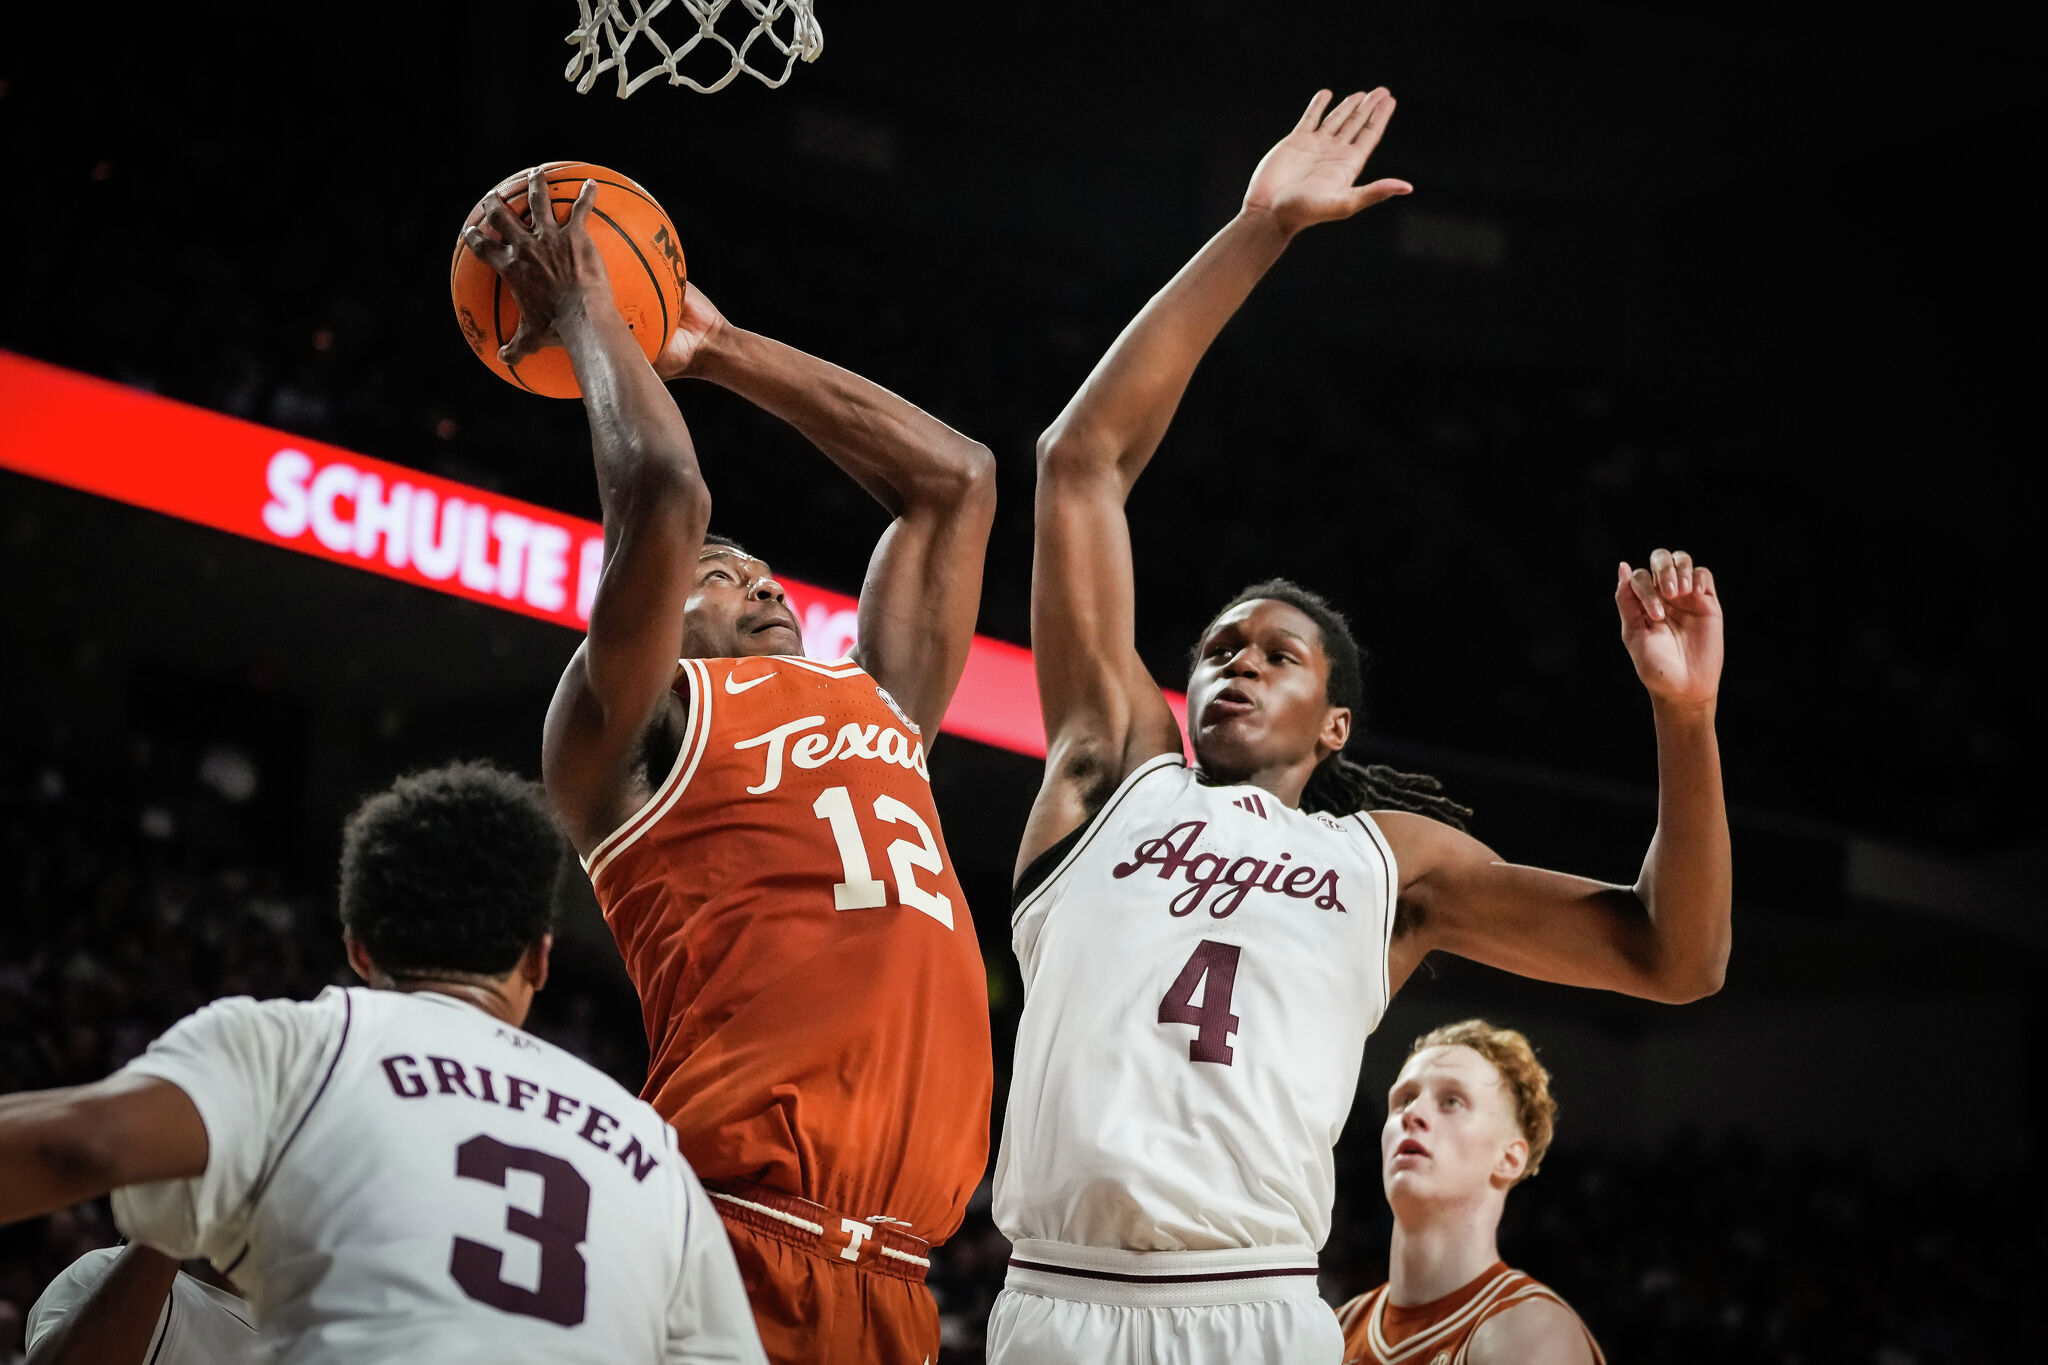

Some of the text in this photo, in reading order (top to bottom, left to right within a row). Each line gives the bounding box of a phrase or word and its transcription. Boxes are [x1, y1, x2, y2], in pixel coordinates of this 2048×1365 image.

[262, 448, 571, 613] SCHULTE
[733, 715, 930, 795] Texas
[812, 786, 954, 931] 12
[1112, 820, 1347, 919] Aggies
[1157, 939, 1242, 1067] 4
[380, 1054, 659, 1184] GRIFFEN
[449, 1133, 591, 1329] 3
[840, 1218, 873, 1262] T
